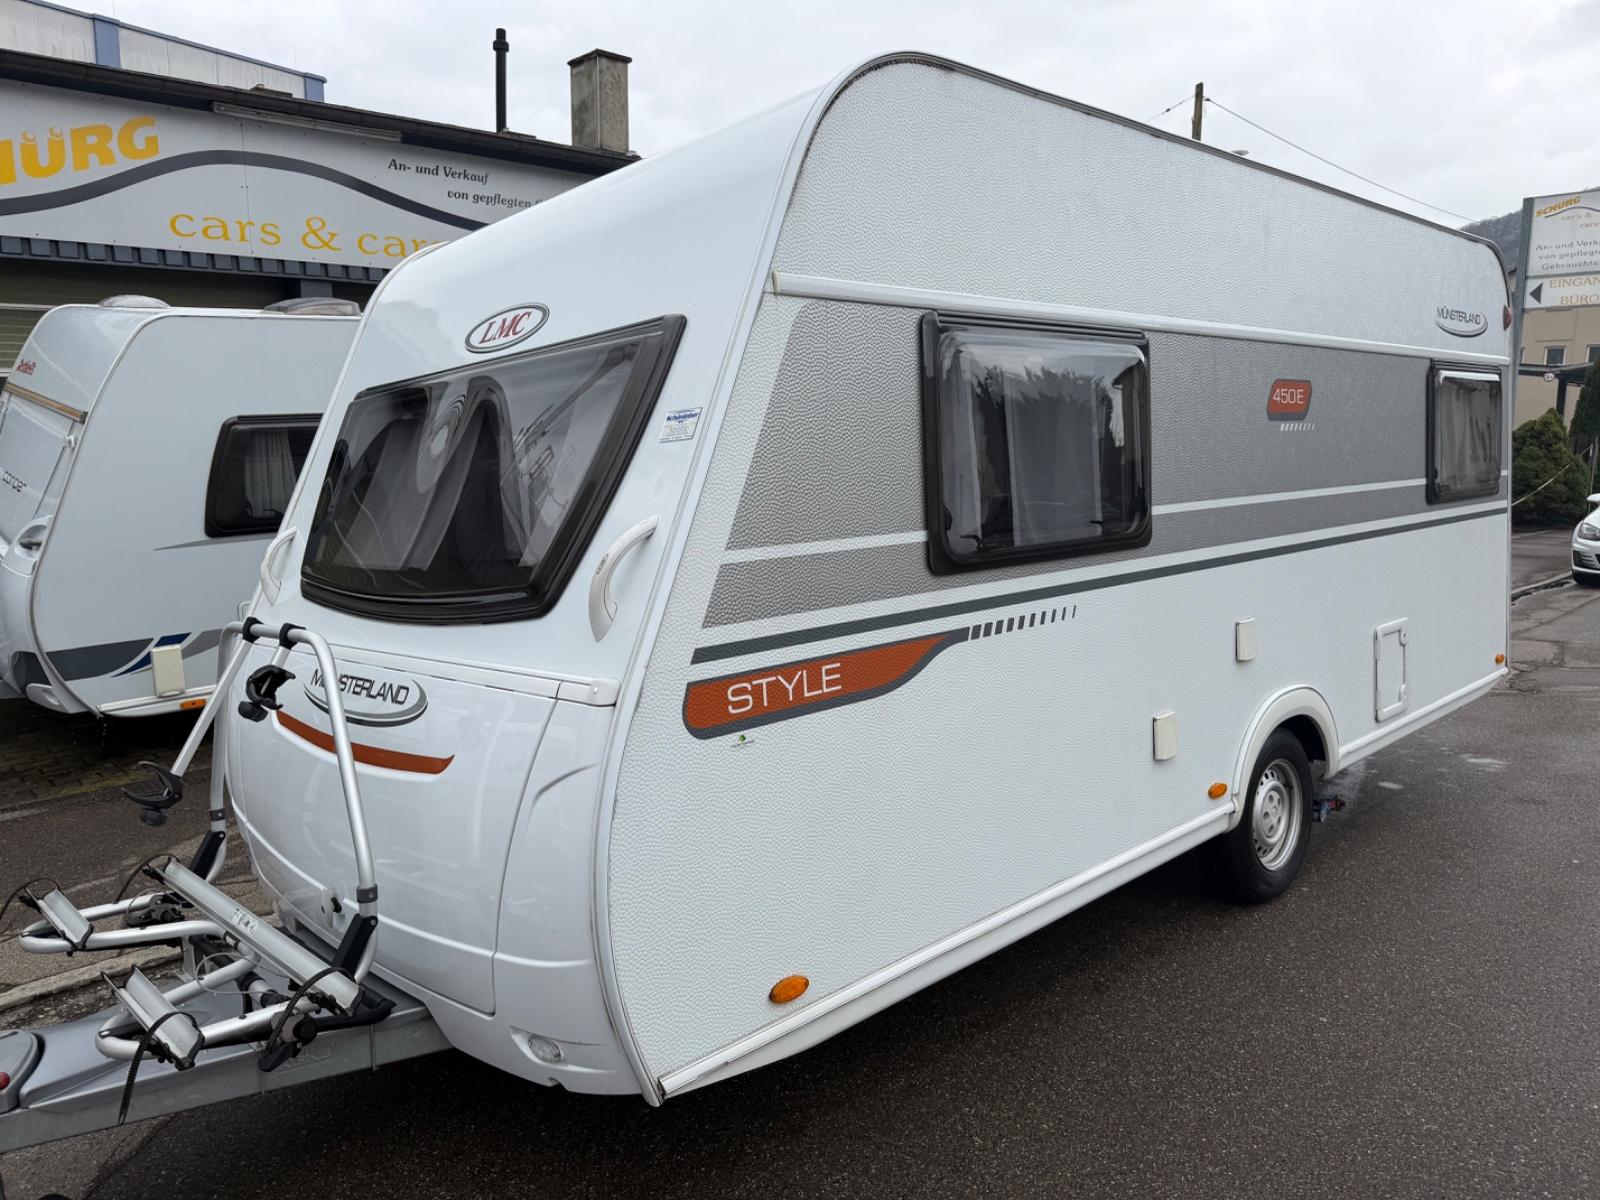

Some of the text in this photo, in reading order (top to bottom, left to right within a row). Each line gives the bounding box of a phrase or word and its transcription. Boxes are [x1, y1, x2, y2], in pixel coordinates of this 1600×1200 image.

[387, 158, 490, 186] An- und Verkauf
[447, 190, 469, 201] von
[472, 193, 531, 209] gepflegten
[169, 213, 441, 257] cars & car
[1555, 241, 1574, 249] und
[479, 310, 533, 345] LMC
[1437, 305, 1480, 325] MÜNSTERLAND
[1273, 389, 1304, 404] 450E
[310, 667, 410, 705] MSTERLAND
[727, 662, 842, 714] STYLE
